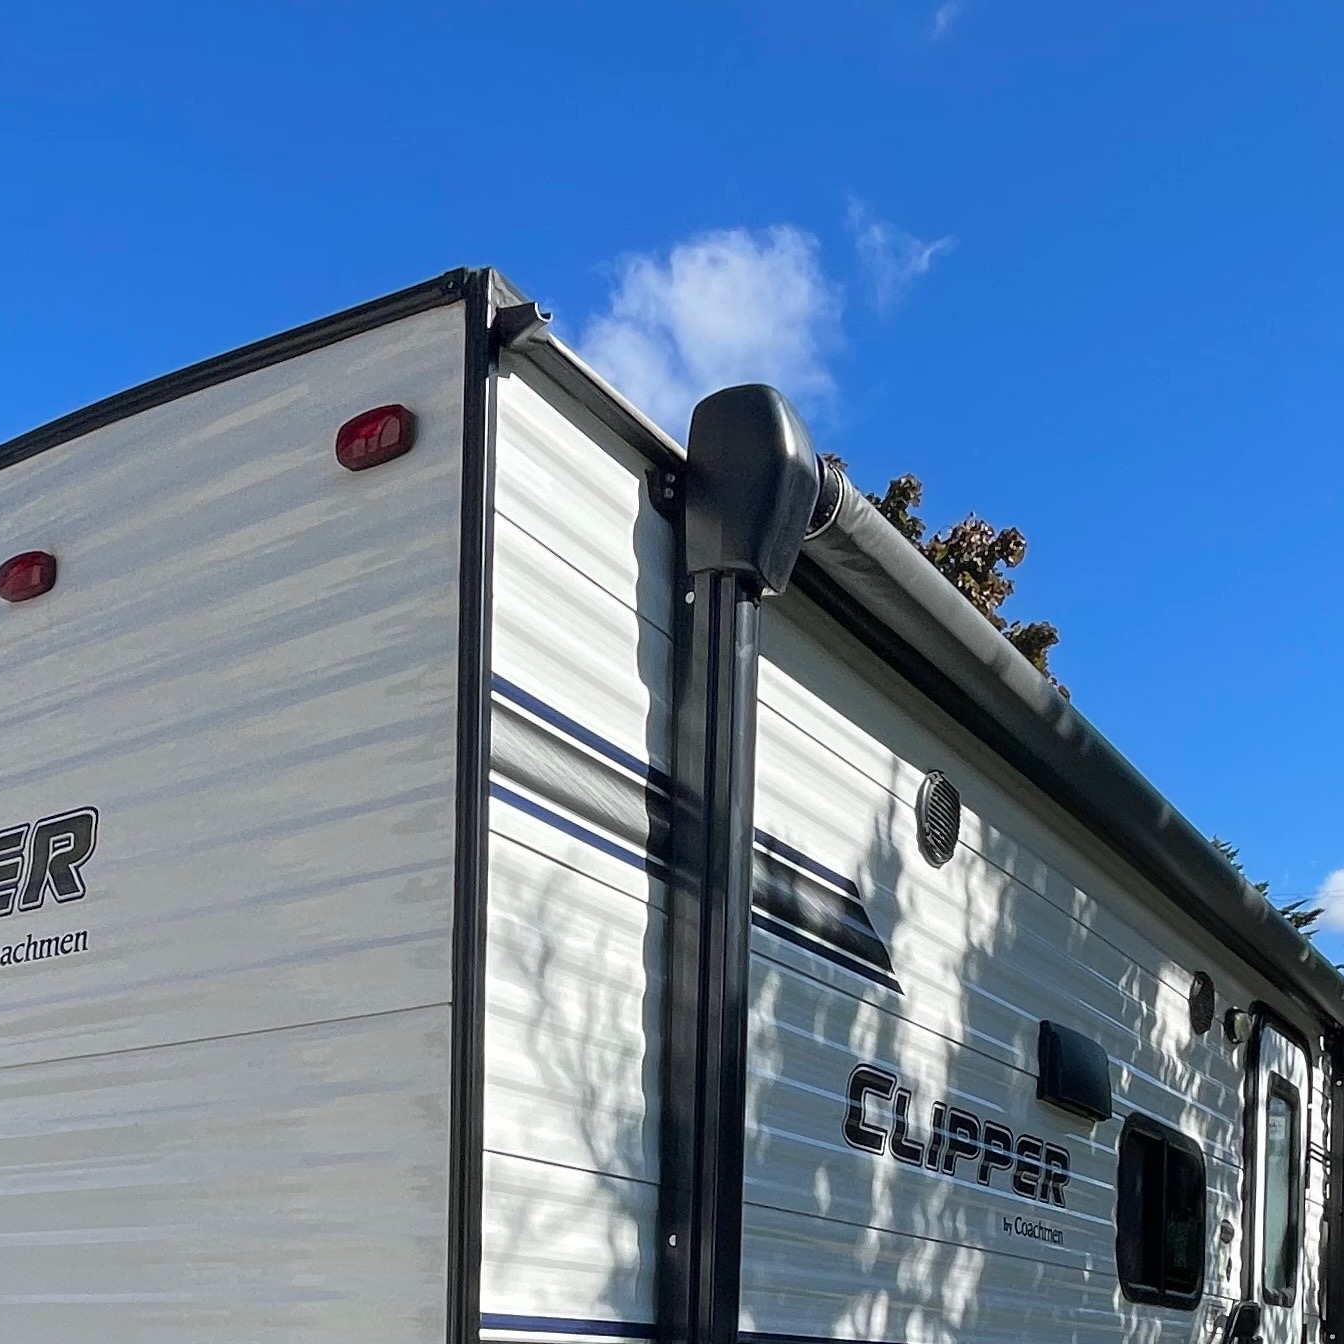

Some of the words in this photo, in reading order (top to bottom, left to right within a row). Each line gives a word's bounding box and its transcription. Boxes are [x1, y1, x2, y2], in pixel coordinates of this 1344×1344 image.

[841, 1063, 1070, 1207] CLIPPER
[1003, 1216, 1013, 1236] by
[1014, 1216, 1064, 1245] Coachmen
